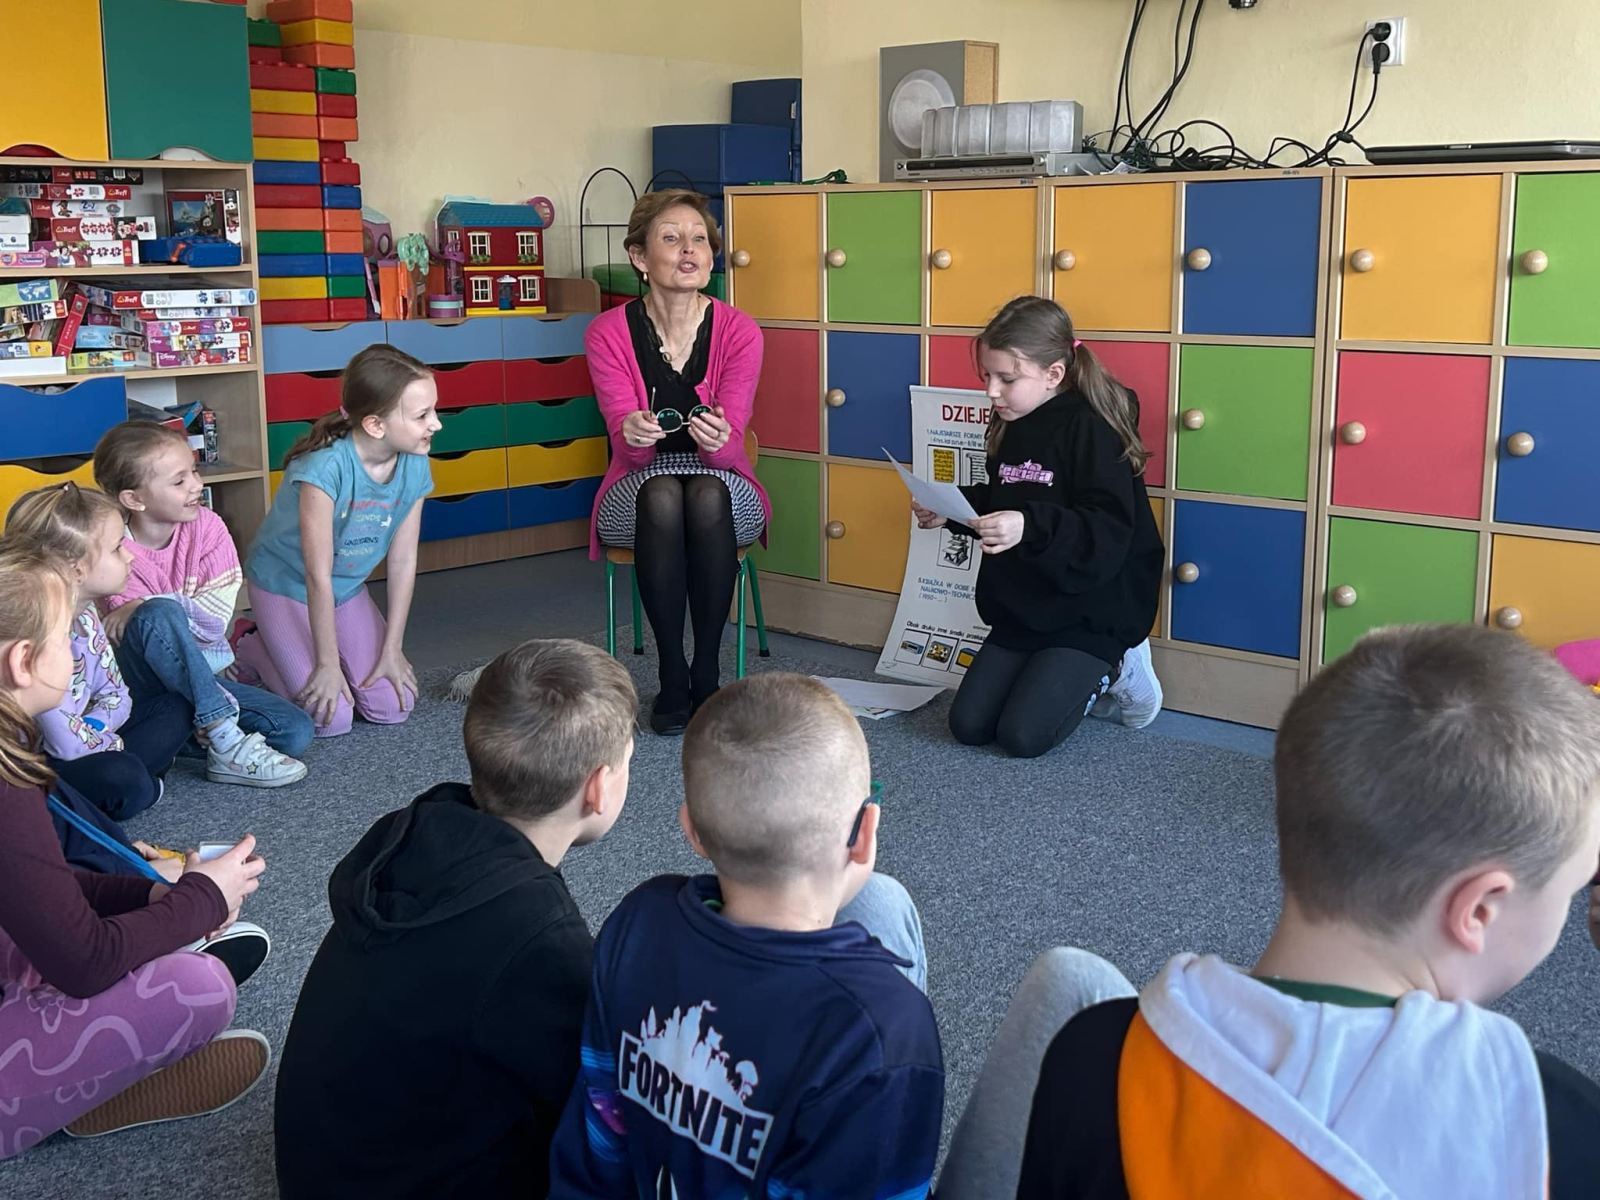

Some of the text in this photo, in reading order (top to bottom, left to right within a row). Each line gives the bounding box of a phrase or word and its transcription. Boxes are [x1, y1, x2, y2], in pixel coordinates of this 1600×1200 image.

[114, 188, 128, 197] Trefl
[62, 225, 77, 233] Trefl
[124, 296, 138, 304] Trefl
[159, 352, 176, 360] Disney
[942, 404, 990, 425] DZIEJE
[620, 1035, 769, 1173] FORTNITE
